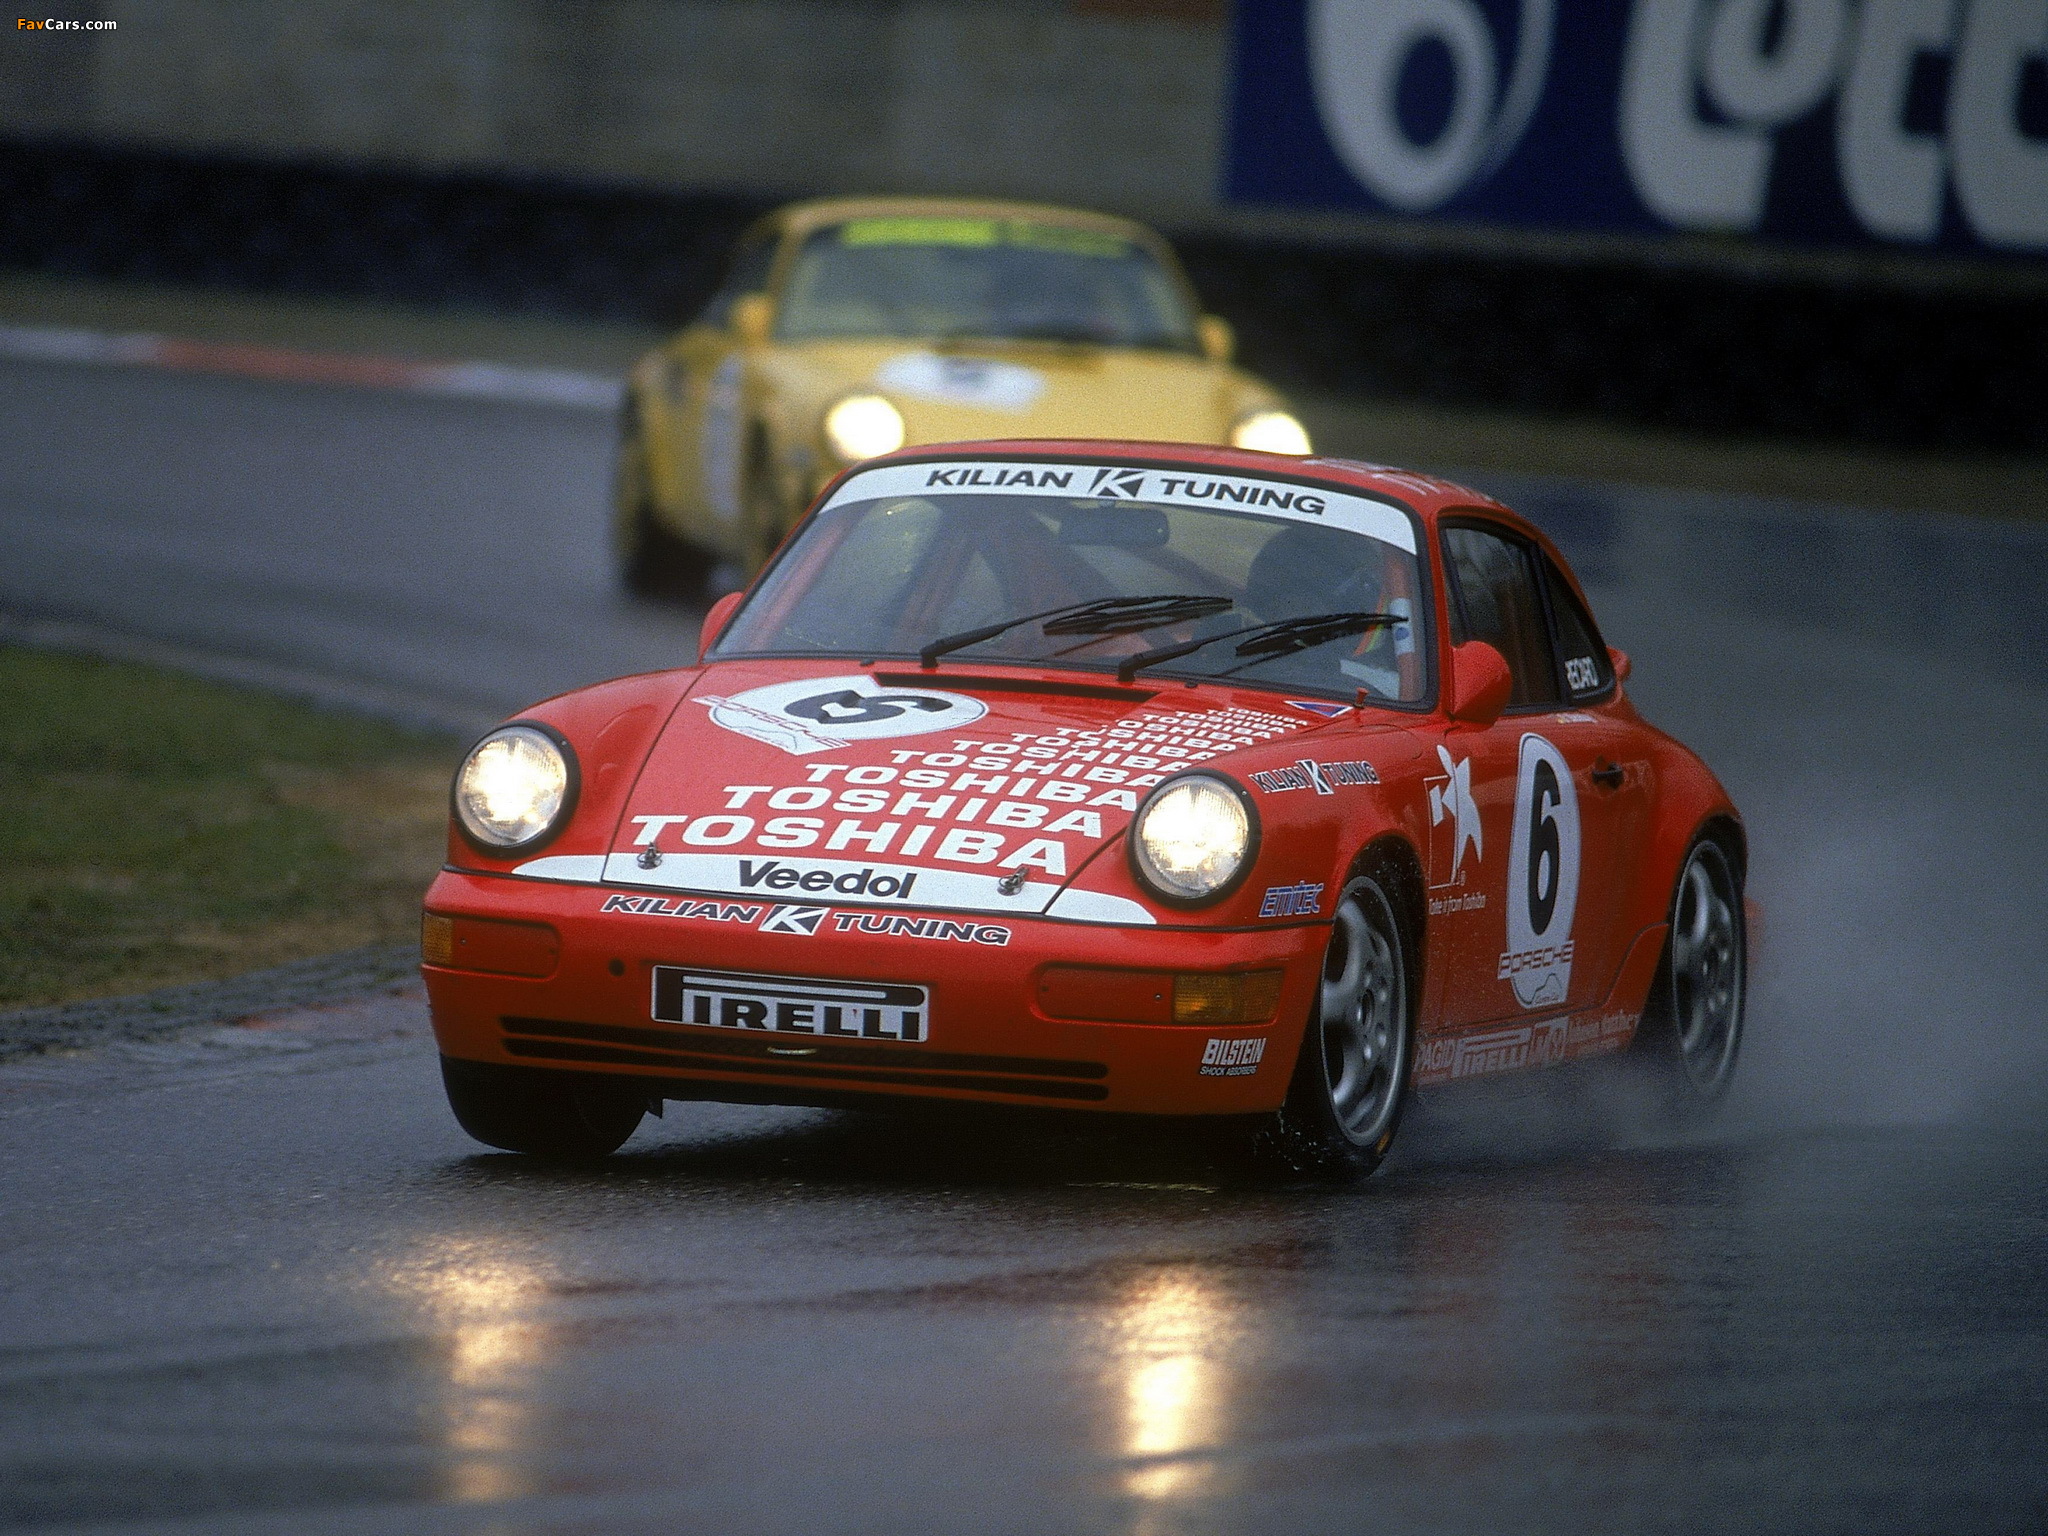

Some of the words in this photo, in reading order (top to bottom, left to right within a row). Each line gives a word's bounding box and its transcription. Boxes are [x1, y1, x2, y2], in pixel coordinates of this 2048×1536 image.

[926, 469, 1072, 489] KILIAN
[1160, 478, 1326, 516] TUNING
[783, 690, 953, 724] 6
[1175, 711, 1285, 734] TOSHIBA
[1206, 709, 1297, 729] TOSHIBA
[1143, 714, 1271, 739] TOSHIBA
[952, 740, 1192, 772] TOSHIBA
[1012, 733, 1217, 761] TOSHIBA
[805, 763, 1137, 811] TOSHIBA
[890, 750, 1166, 788] TOSHIBA
[1249, 768, 1313, 793] KILIAN
[1322, 761, 1380, 786] TUNING
[722, 785, 1101, 838] TOSHIBA
[631, 815, 1066, 876] TOSHIBA
[1528, 758, 1561, 935] 6
[739, 860, 917, 898] Veedol
[601, 895, 762, 923] KILIAN
[833, 913, 1011, 946] TUNING
[1499, 943, 1573, 973] PORSCHE
[655, 967, 924, 1040] PIRELLI
[1201, 1038, 1267, 1065] BILSTEIN
[1451, 1027, 1531, 1078] PIRELLI
[1200, 1066, 1225, 1076] SHOCK
